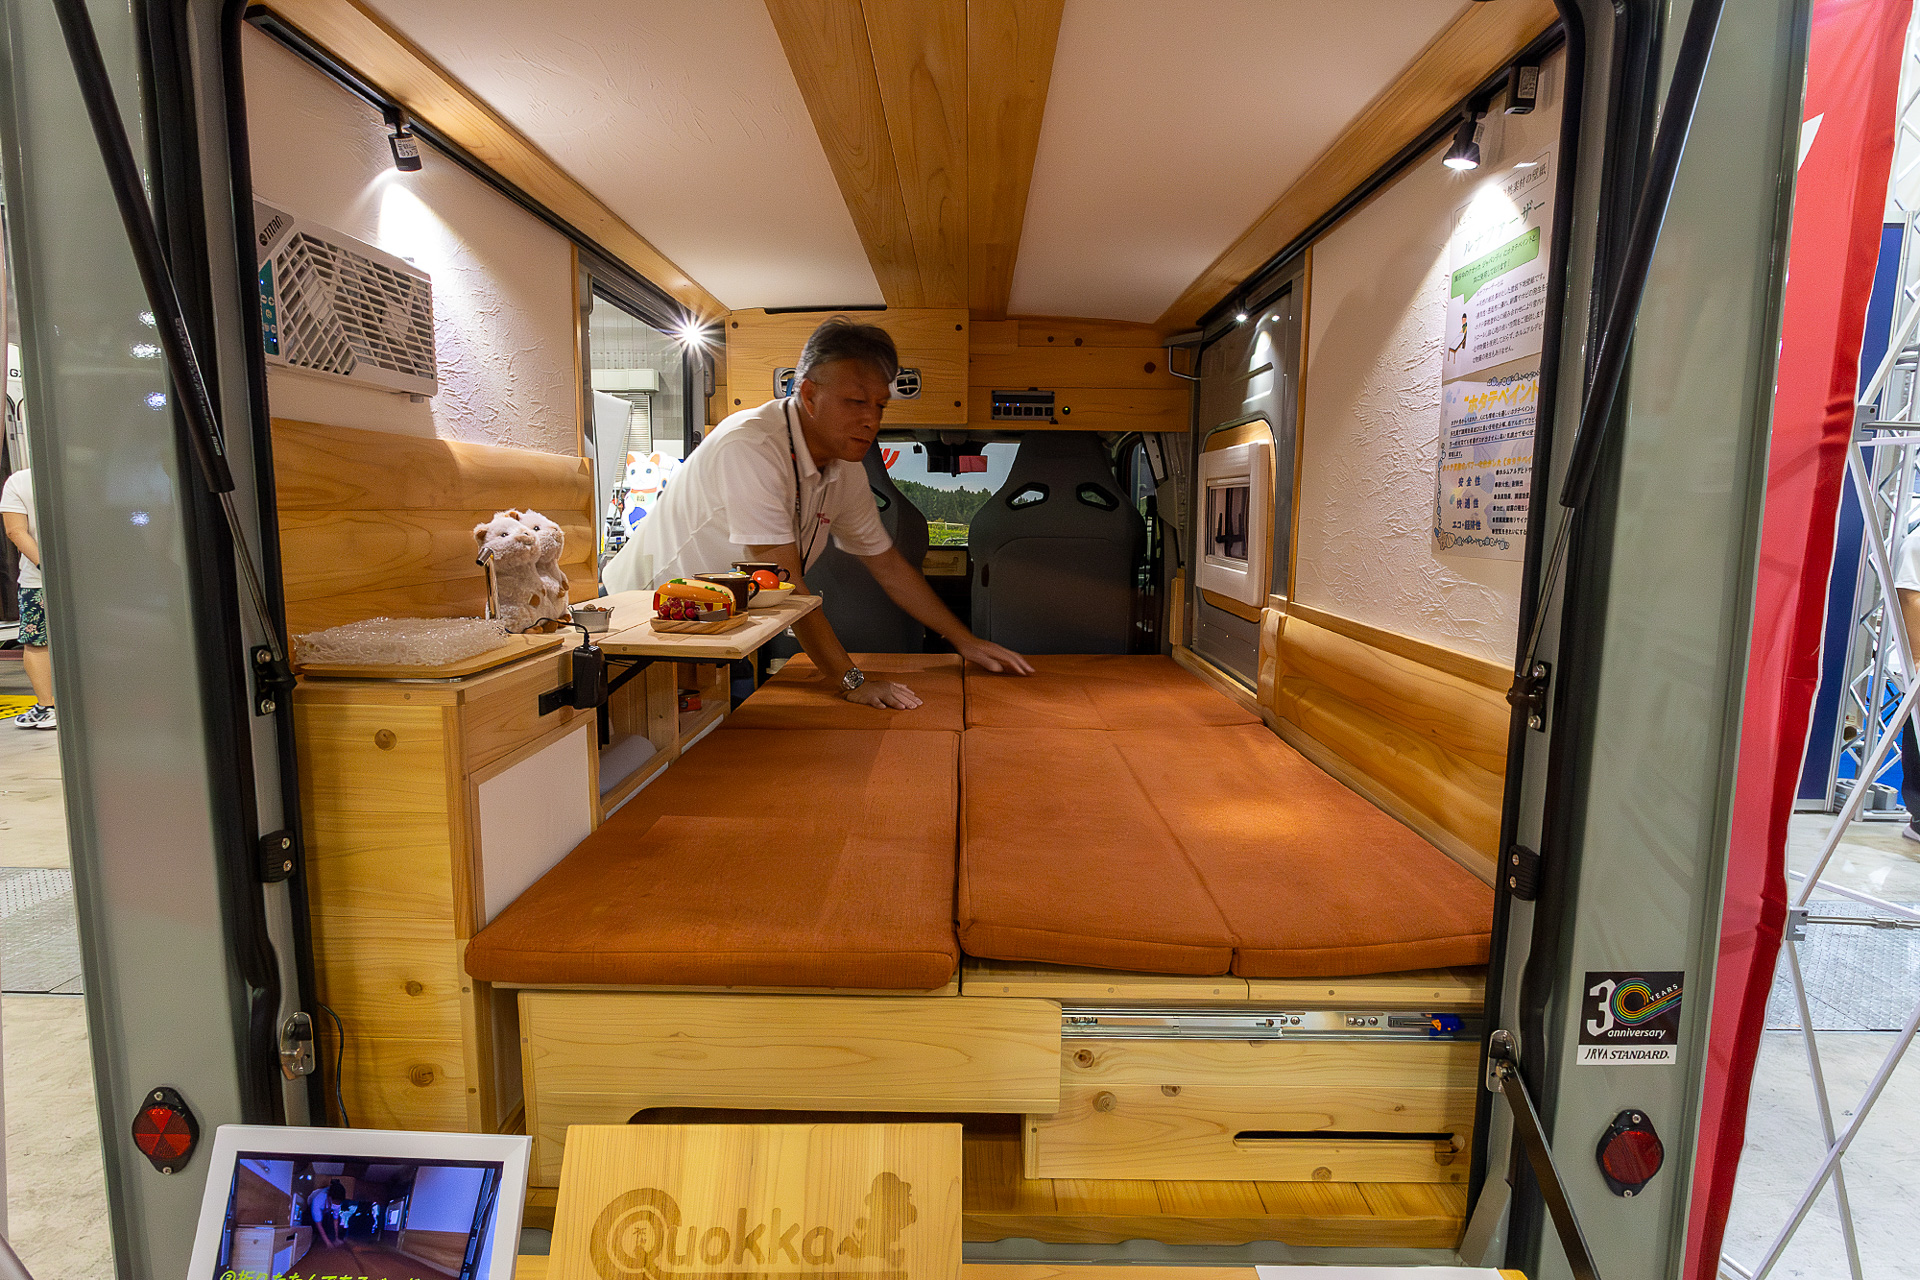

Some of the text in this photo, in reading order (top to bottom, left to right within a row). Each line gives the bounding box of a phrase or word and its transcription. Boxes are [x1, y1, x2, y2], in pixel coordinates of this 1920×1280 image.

[264, 215, 284, 240] TITAN
[1649, 983, 1679, 1002] YEARS
[1607, 1028, 1666, 1039] anniversary
[590, 1187, 836, 1280] Quokka
